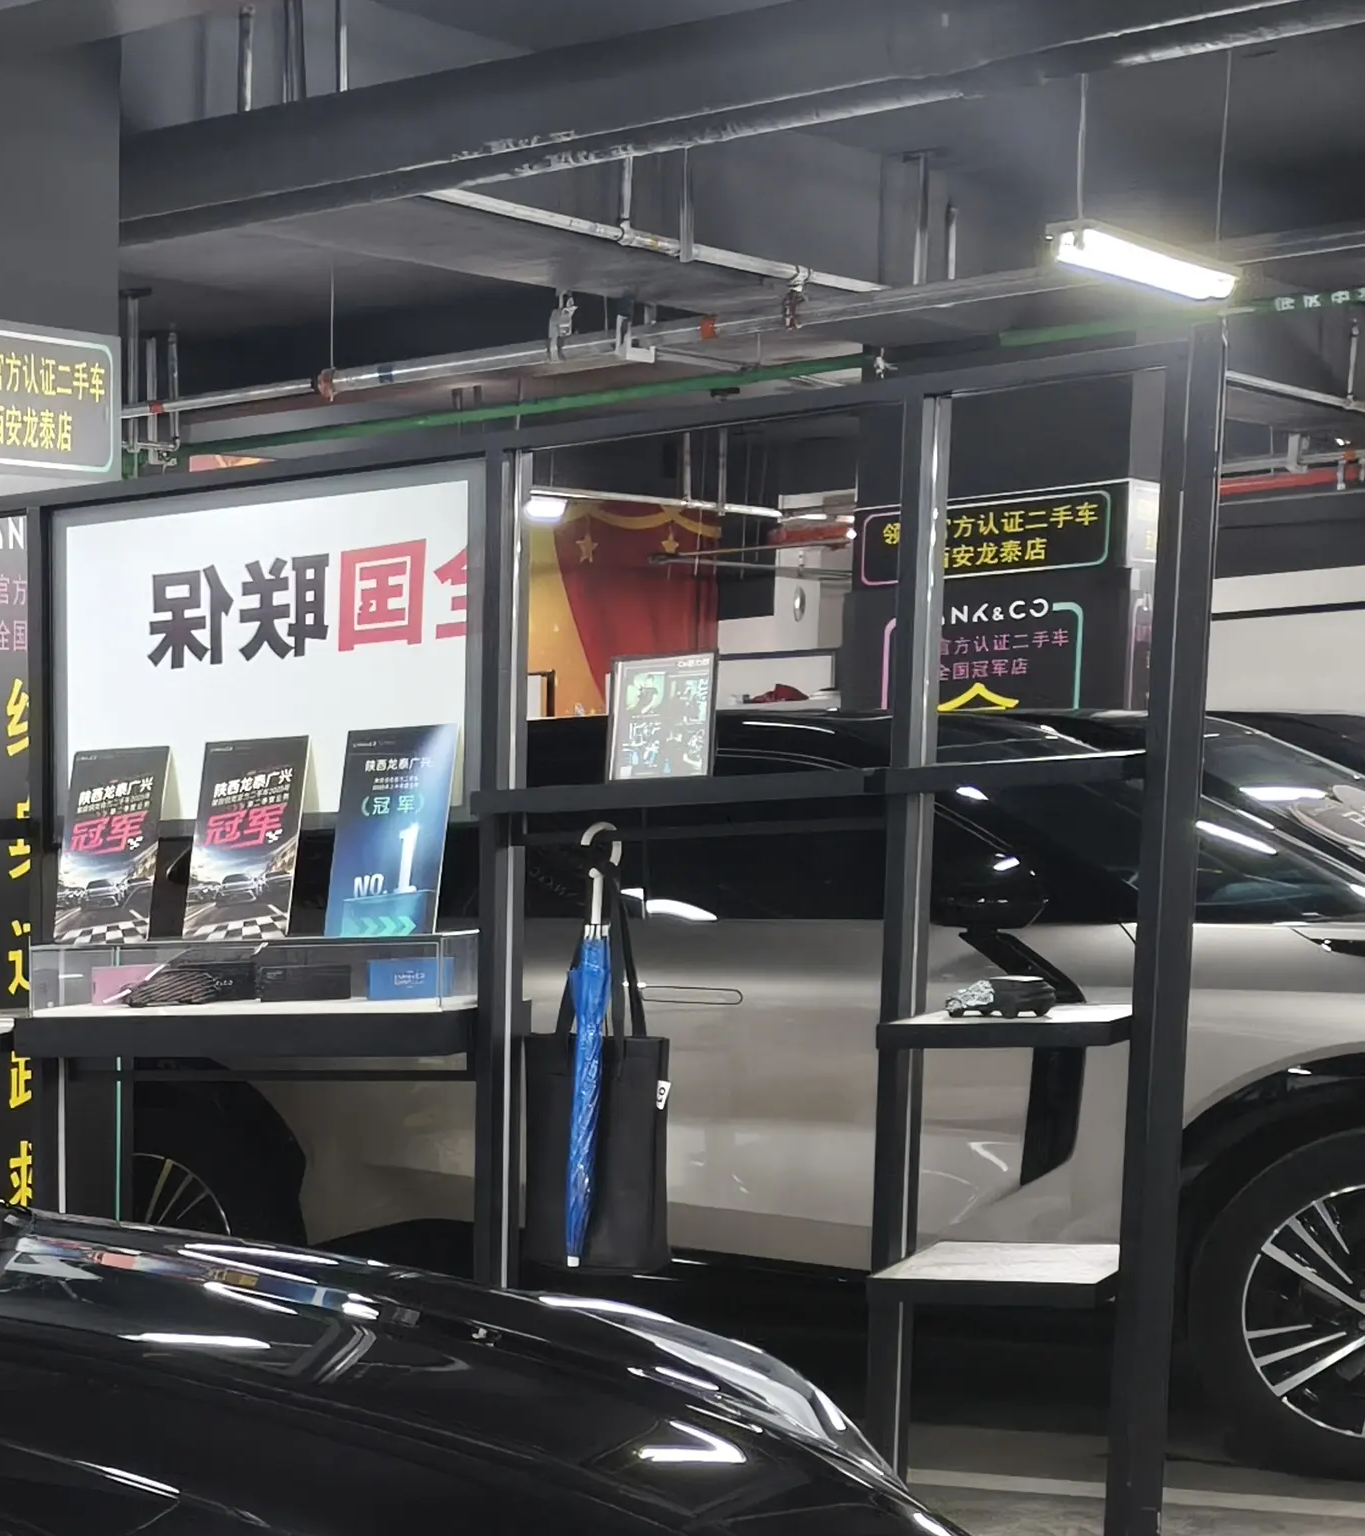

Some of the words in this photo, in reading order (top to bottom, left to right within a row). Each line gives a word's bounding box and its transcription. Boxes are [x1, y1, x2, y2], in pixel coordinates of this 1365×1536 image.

[940, 598, 1050, 627] NK&CO
[71, 811, 149, 854] 冠军
[204, 802, 289, 848] 冠军
